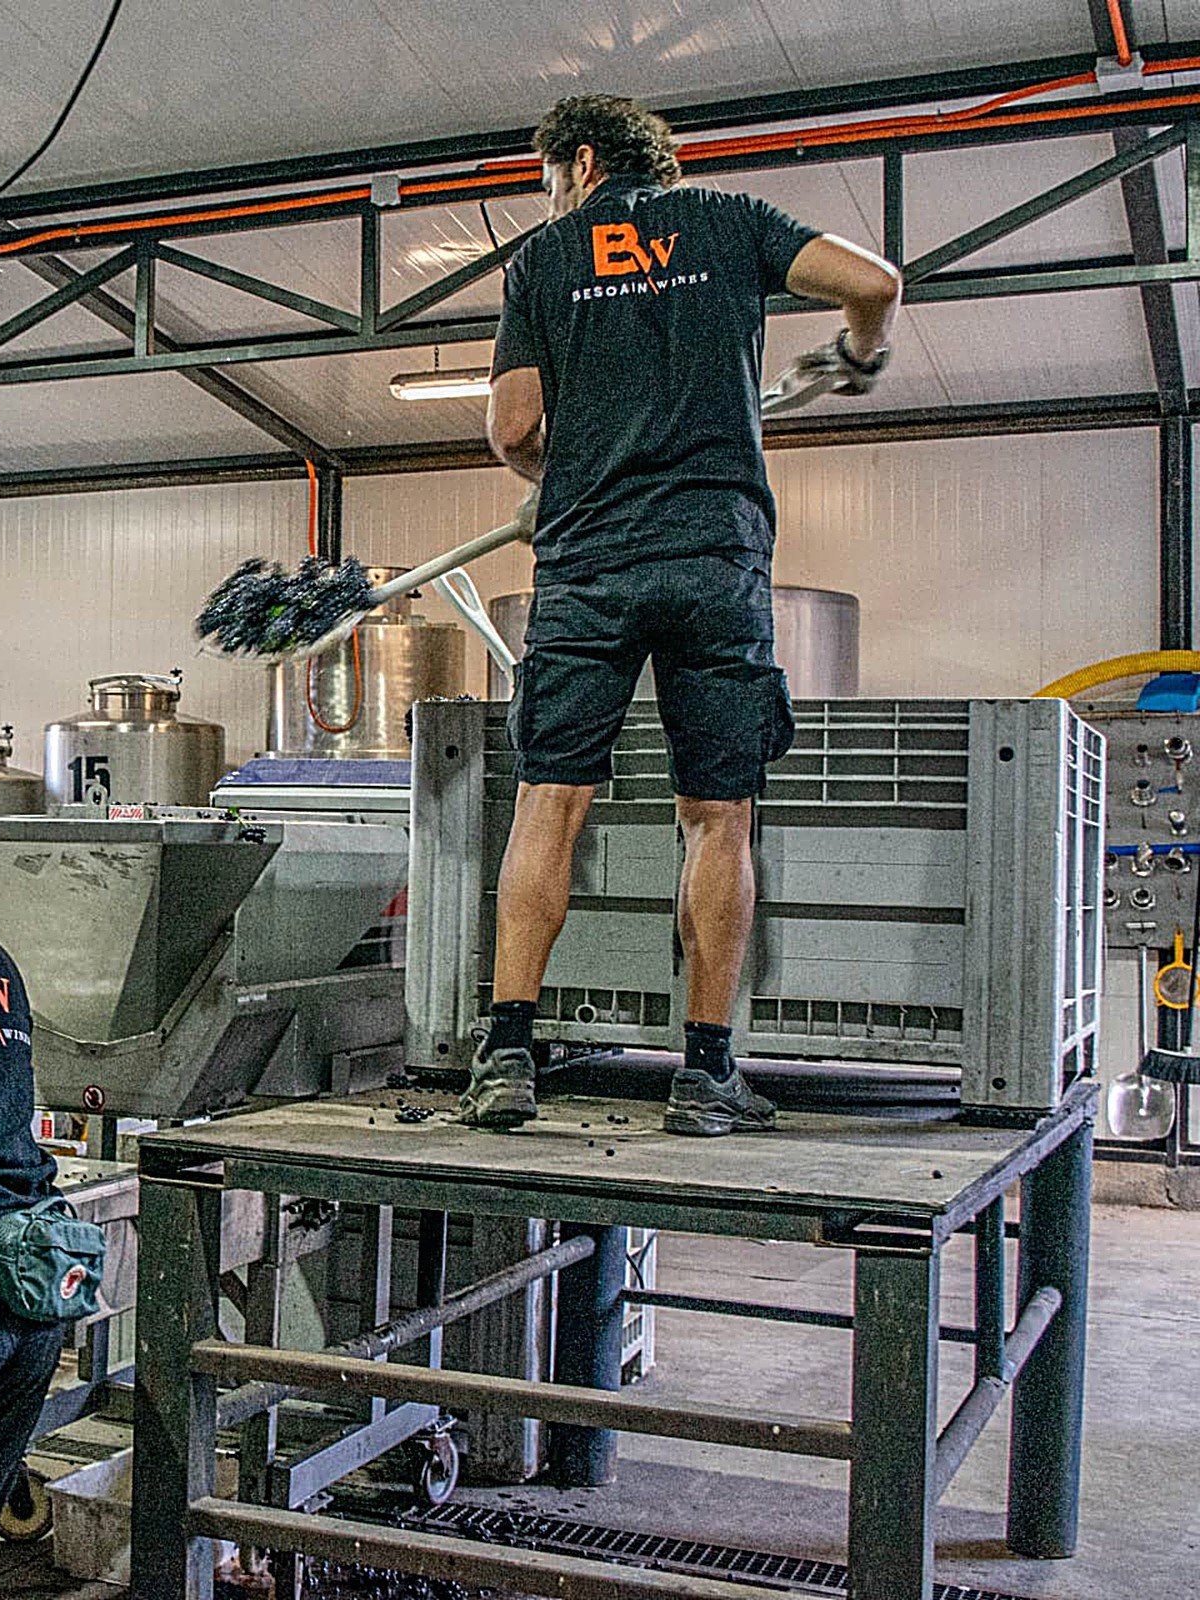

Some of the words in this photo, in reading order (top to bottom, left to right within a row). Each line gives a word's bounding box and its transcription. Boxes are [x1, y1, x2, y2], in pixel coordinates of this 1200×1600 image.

[571, 281, 648, 303] BESOAIN
[656, 272, 709, 290] WINES
[68, 756, 111, 803] 15
